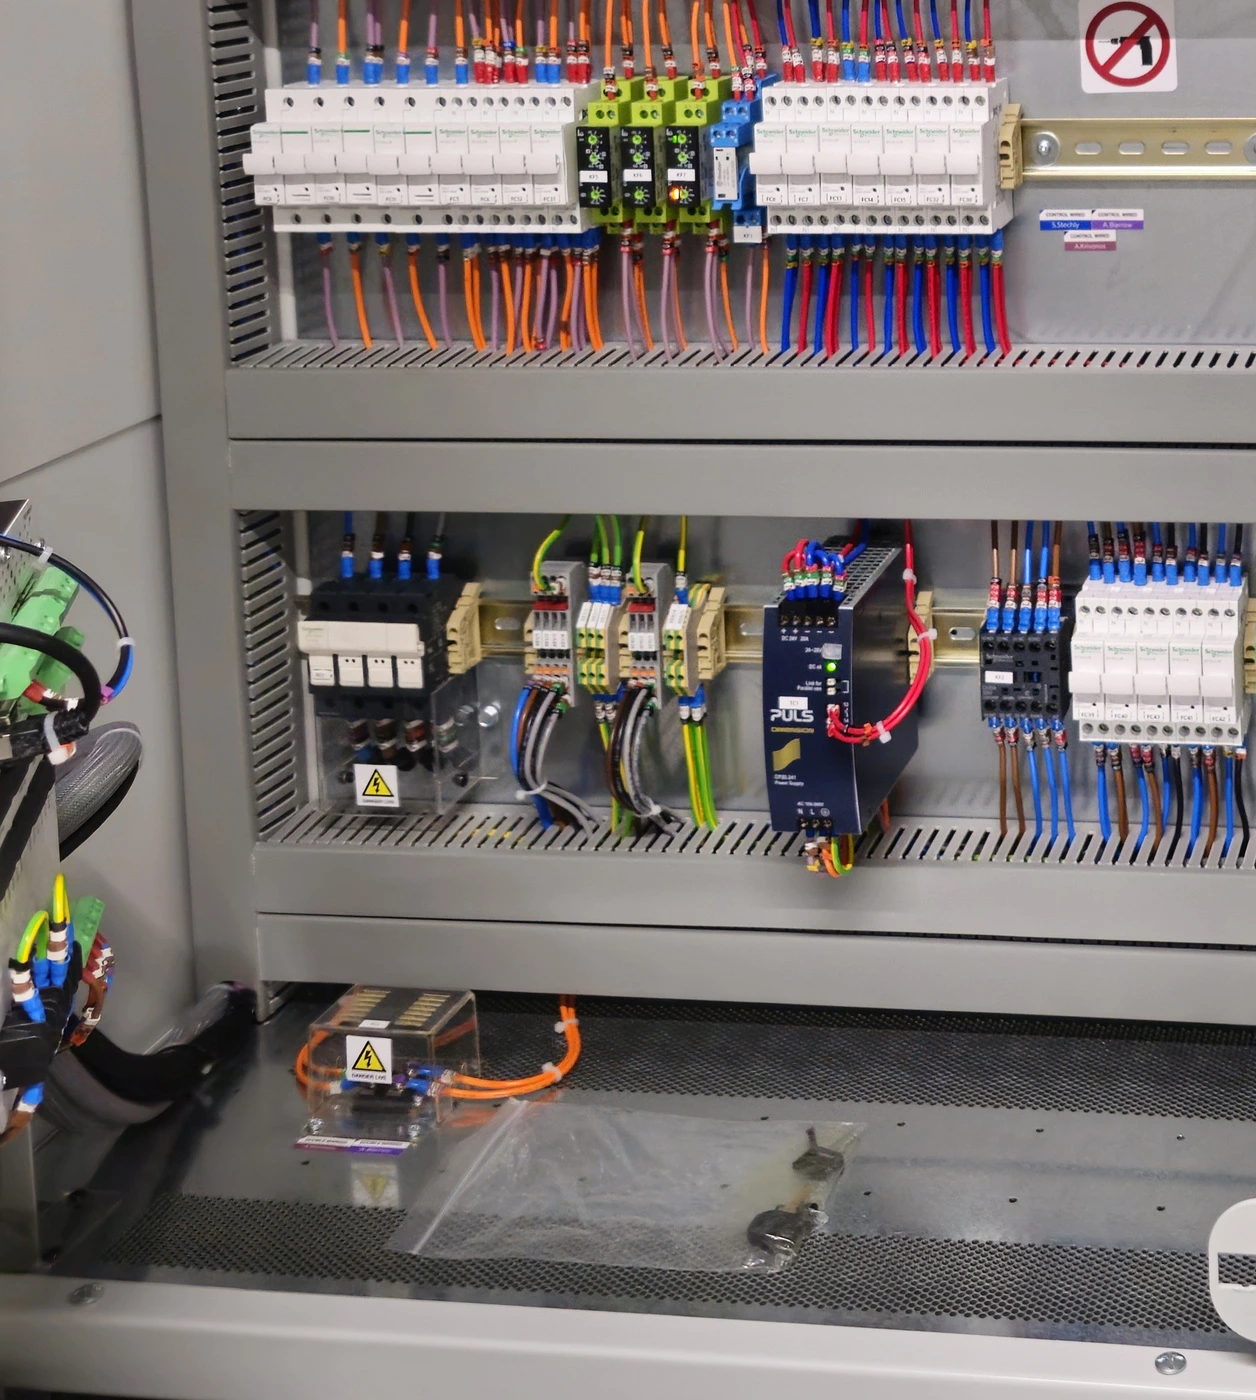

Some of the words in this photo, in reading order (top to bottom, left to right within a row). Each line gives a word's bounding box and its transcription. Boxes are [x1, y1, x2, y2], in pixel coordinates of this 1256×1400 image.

[756, 128, 785, 136] Schneider
[788, 129, 817, 137] Schneider
[822, 127, 850, 135] Schneider
[852, 128, 881, 137] Schneider
[886, 128, 914, 137] Schneider
[919, 128, 947, 136] Schneider
[952, 128, 980, 136] Schneider
[1074, 644, 1102, 652] Schneider
[1107, 645, 1135, 653] Schneider
[1140, 645, 1167, 653] Schneider
[986, 653, 1014, 661] Schneider
[770, 709, 814, 723] PULS
